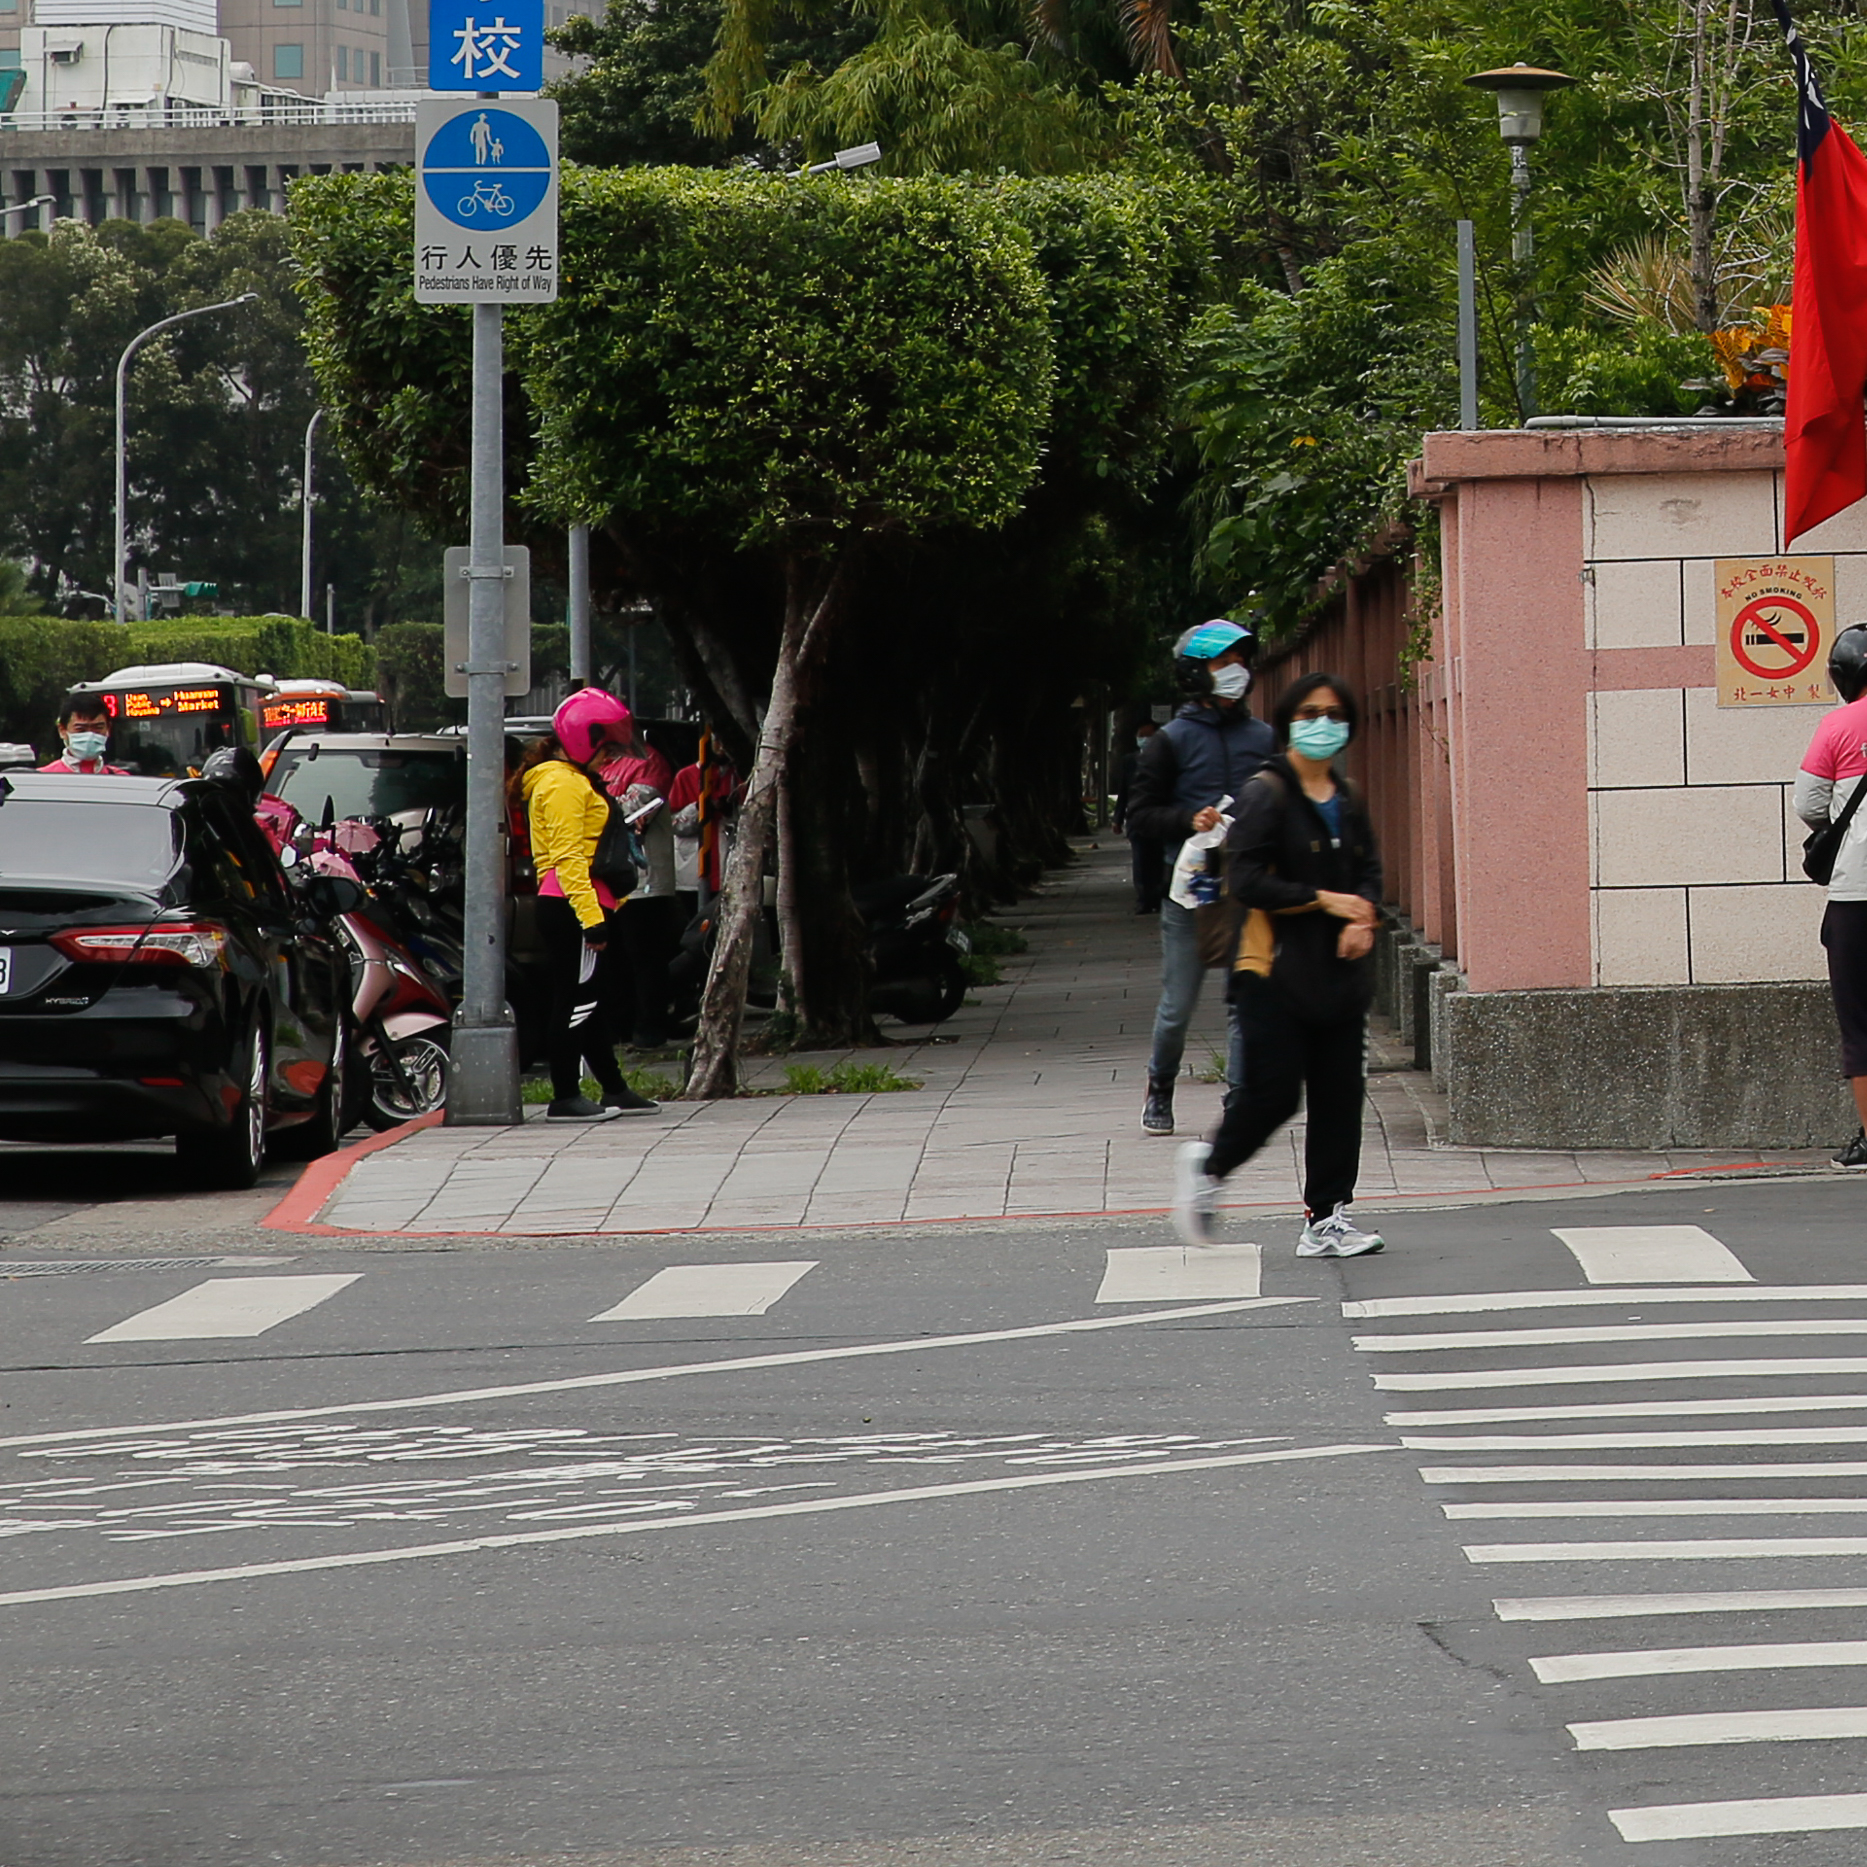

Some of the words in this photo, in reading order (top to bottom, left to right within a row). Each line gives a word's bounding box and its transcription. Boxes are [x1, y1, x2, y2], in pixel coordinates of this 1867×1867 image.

[421, 244, 552, 271] 行人優先
[418, 275, 470, 290] Pedestrians
[472, 275, 494, 290] Have
[496, 275, 519, 293] Right
[521, 275, 531, 290] of
[533, 275, 552, 293] Way
[1744, 591, 1758, 602] NO
[1760, 587, 1803, 600] SMOKING
[1733, 684, 1796, 702] 北一女中
[177, 700, 220, 712] Market
